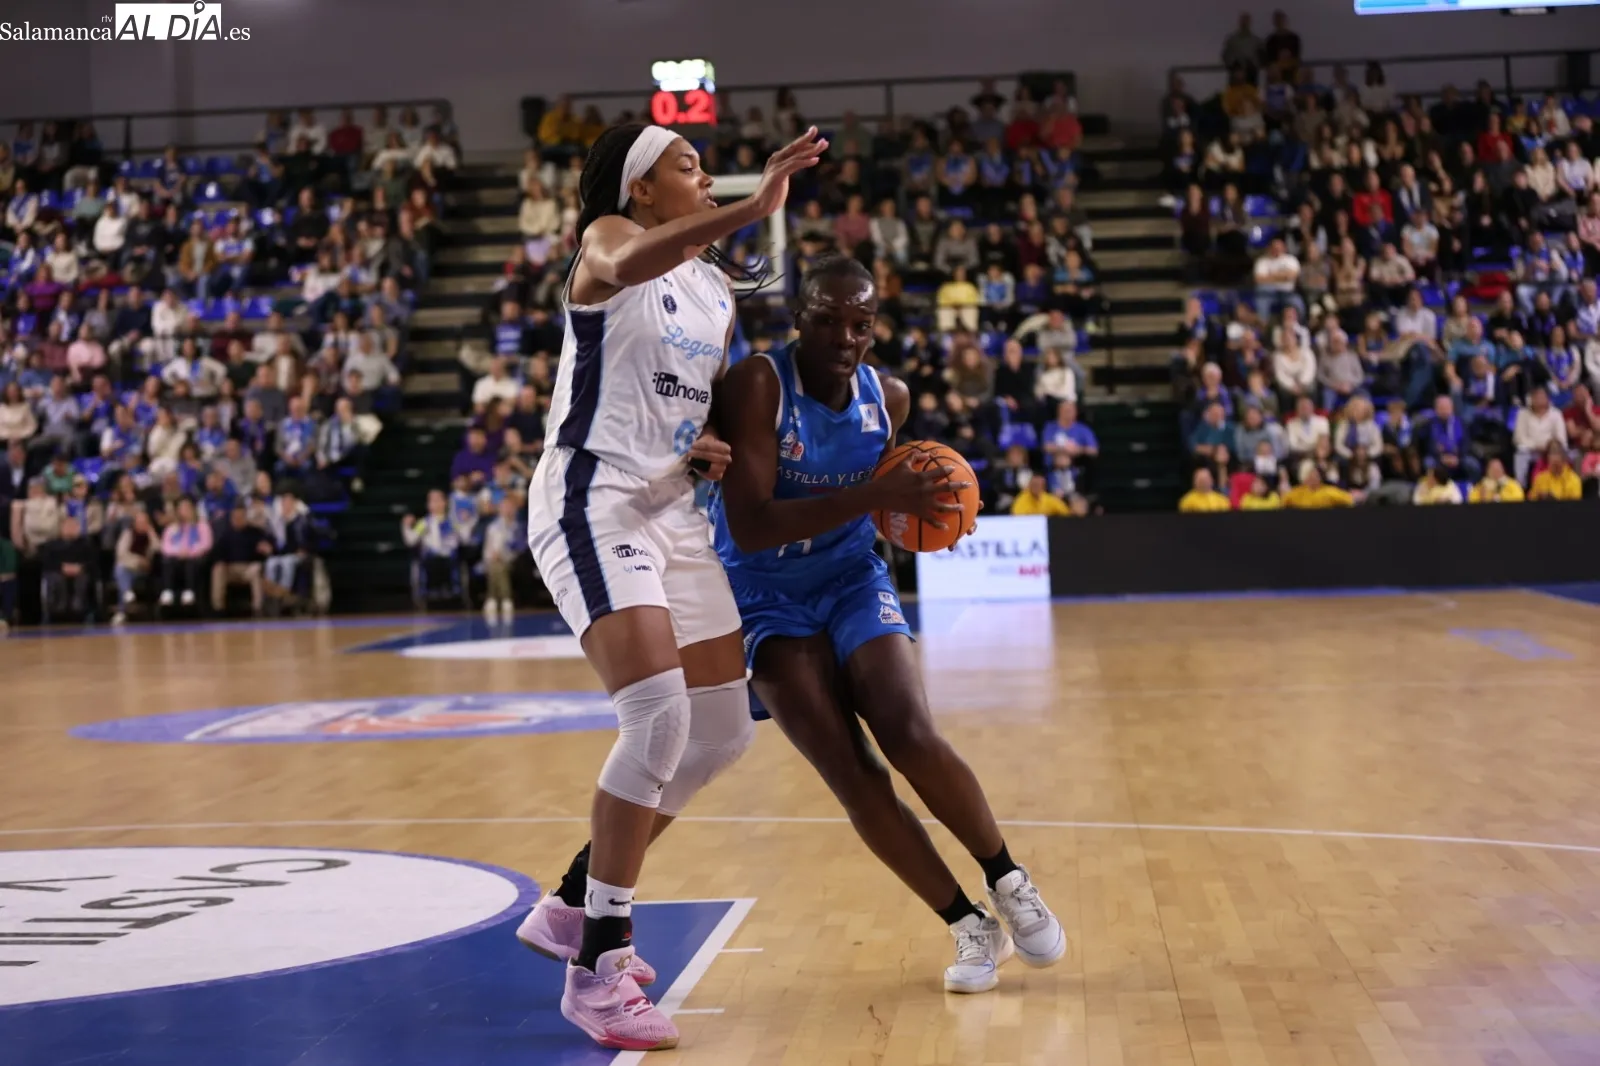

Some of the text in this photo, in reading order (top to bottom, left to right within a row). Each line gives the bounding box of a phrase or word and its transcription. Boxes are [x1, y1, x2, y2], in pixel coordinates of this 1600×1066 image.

[651, 90, 712, 125] 0.2
[661, 325, 724, 361] Legan
[777, 466, 829, 484] ASTILLA
[837, 473, 846, 485] Y
